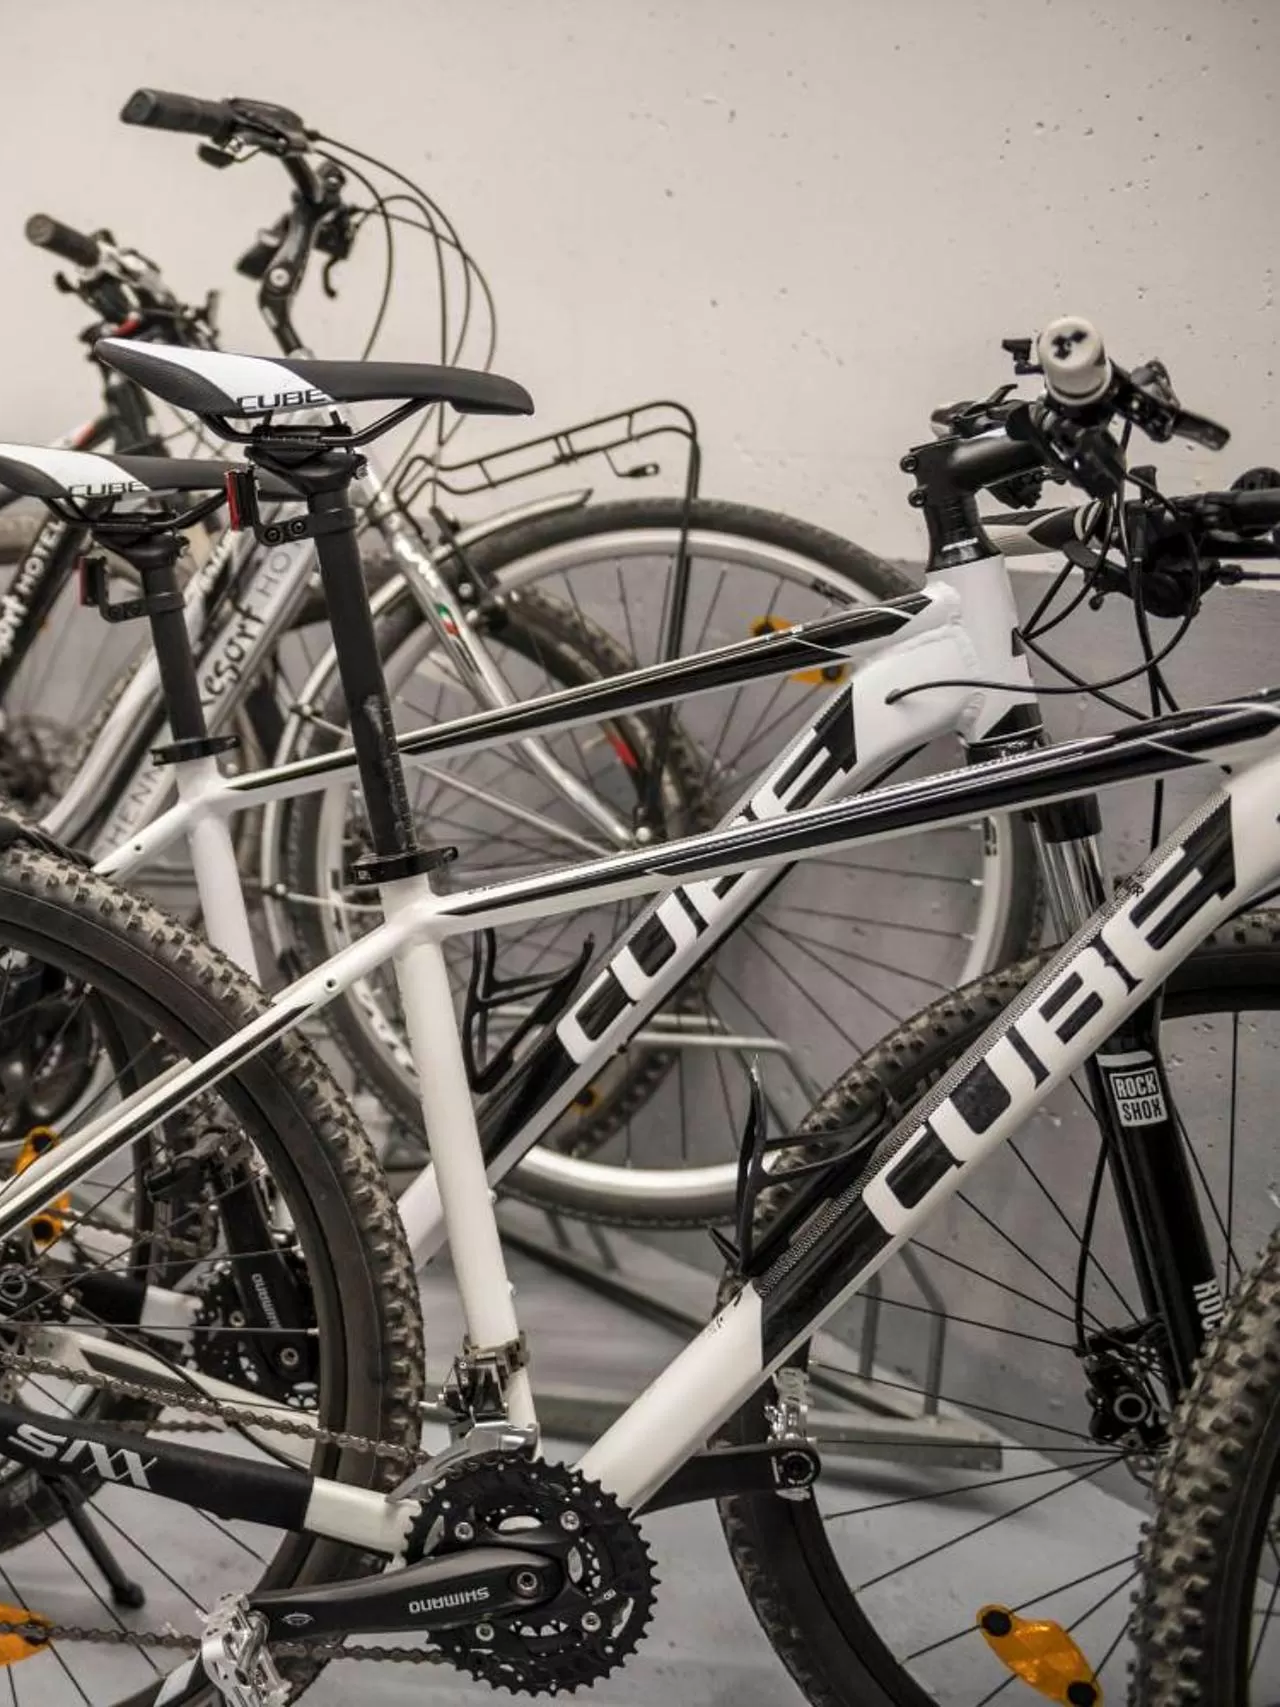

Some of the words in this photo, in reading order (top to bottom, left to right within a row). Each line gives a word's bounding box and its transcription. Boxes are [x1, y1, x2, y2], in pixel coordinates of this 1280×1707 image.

[236, 388, 326, 412] CUBE
[69, 482, 149, 498] CUBE
[15, 519, 68, 596] HOTEL
[104, 763, 164, 848] HENN
[201, 602, 265, 707] esort
[863, 845, 1225, 1235] CUBE
[1115, 1073, 1157, 1099] ROCK
[1121, 1098, 1163, 1122] SHOX
[1193, 1278, 1226, 1331] ROC
[408, 1586, 491, 1614] SHIMANO
